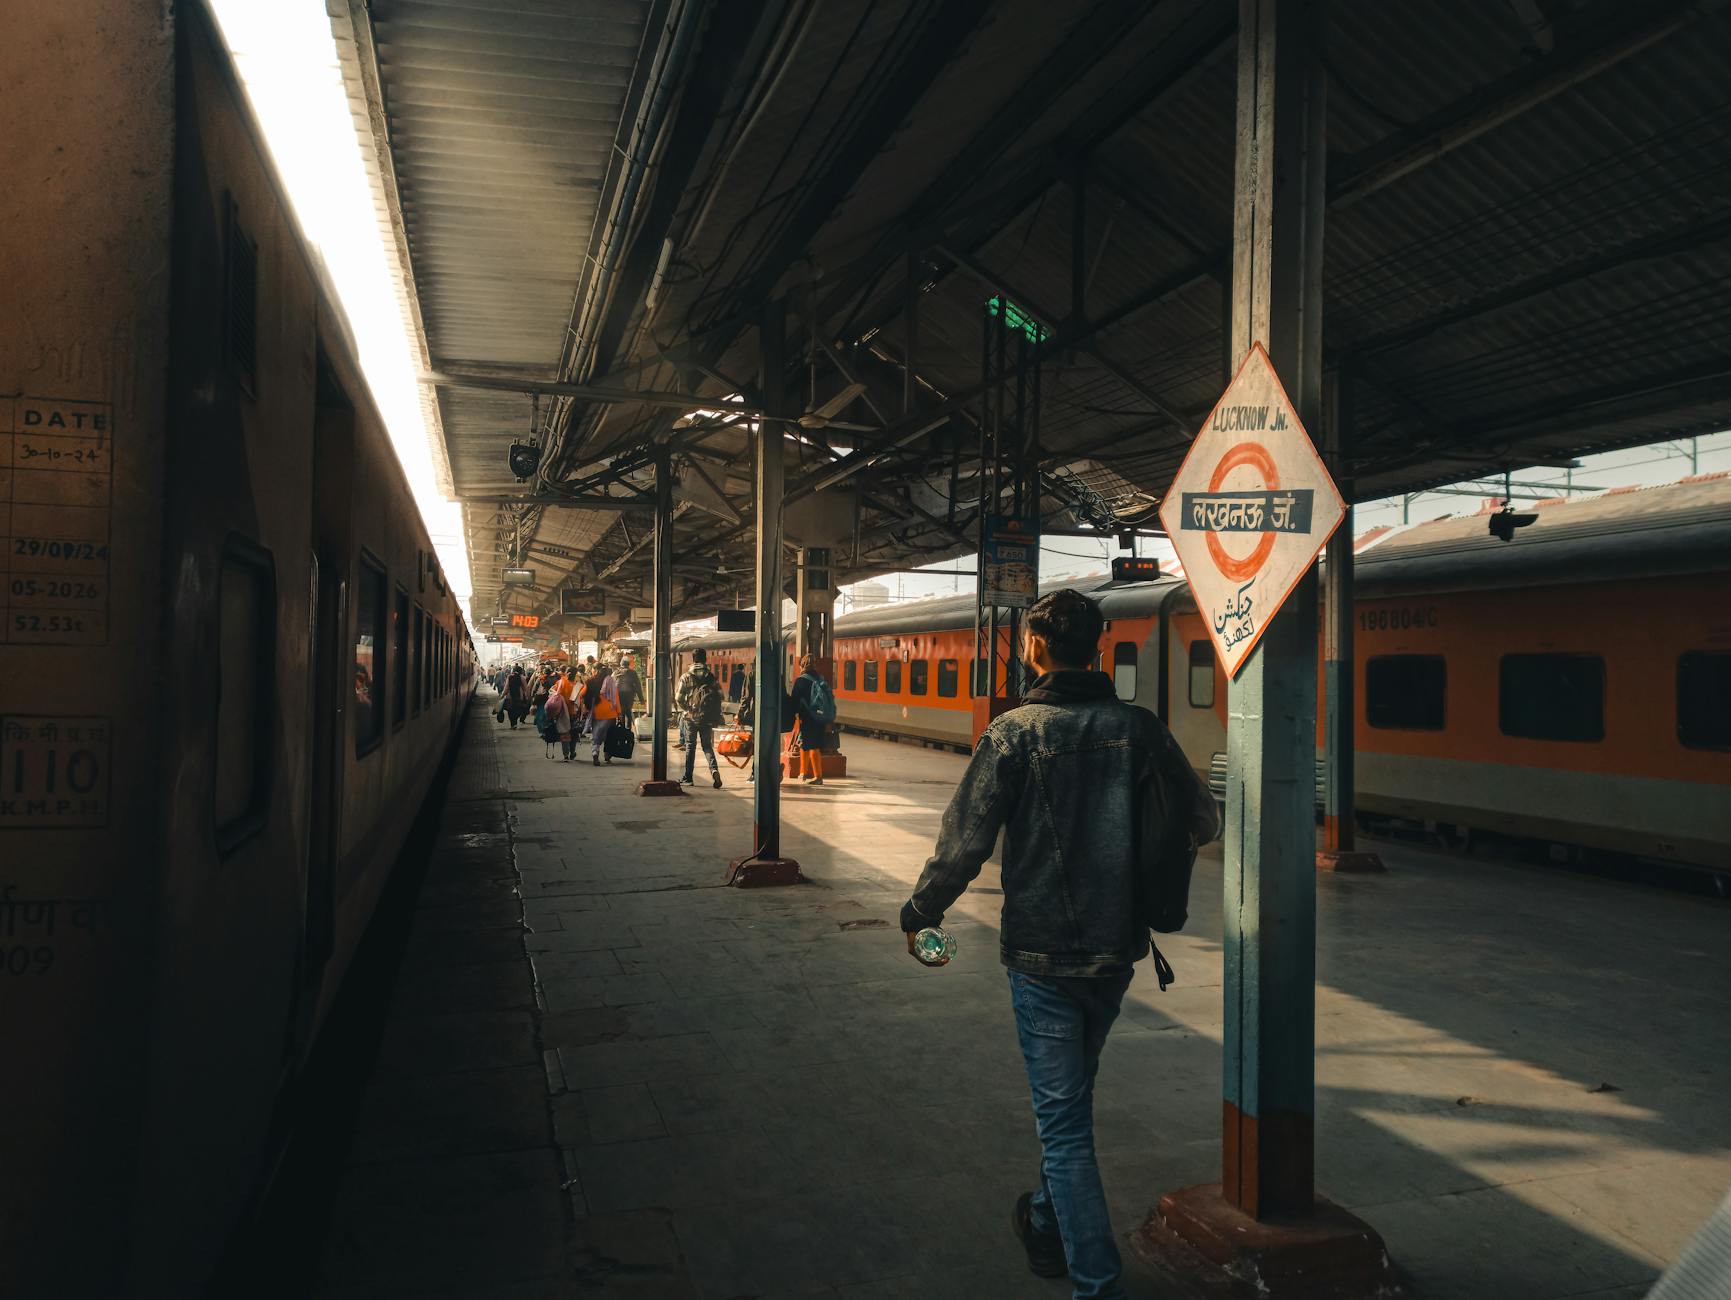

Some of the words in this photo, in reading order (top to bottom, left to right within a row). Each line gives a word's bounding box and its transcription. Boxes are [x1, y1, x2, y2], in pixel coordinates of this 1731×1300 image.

[24, 409, 106, 430] DATE
[1212, 405, 1270, 432] LUCKNOW
[1192, 497, 1267, 531] लखनऊ
[11, 580, 98, 599] 05-2026
[511, 615, 539, 628] 14:03
[15, 749, 99, 794] 110
